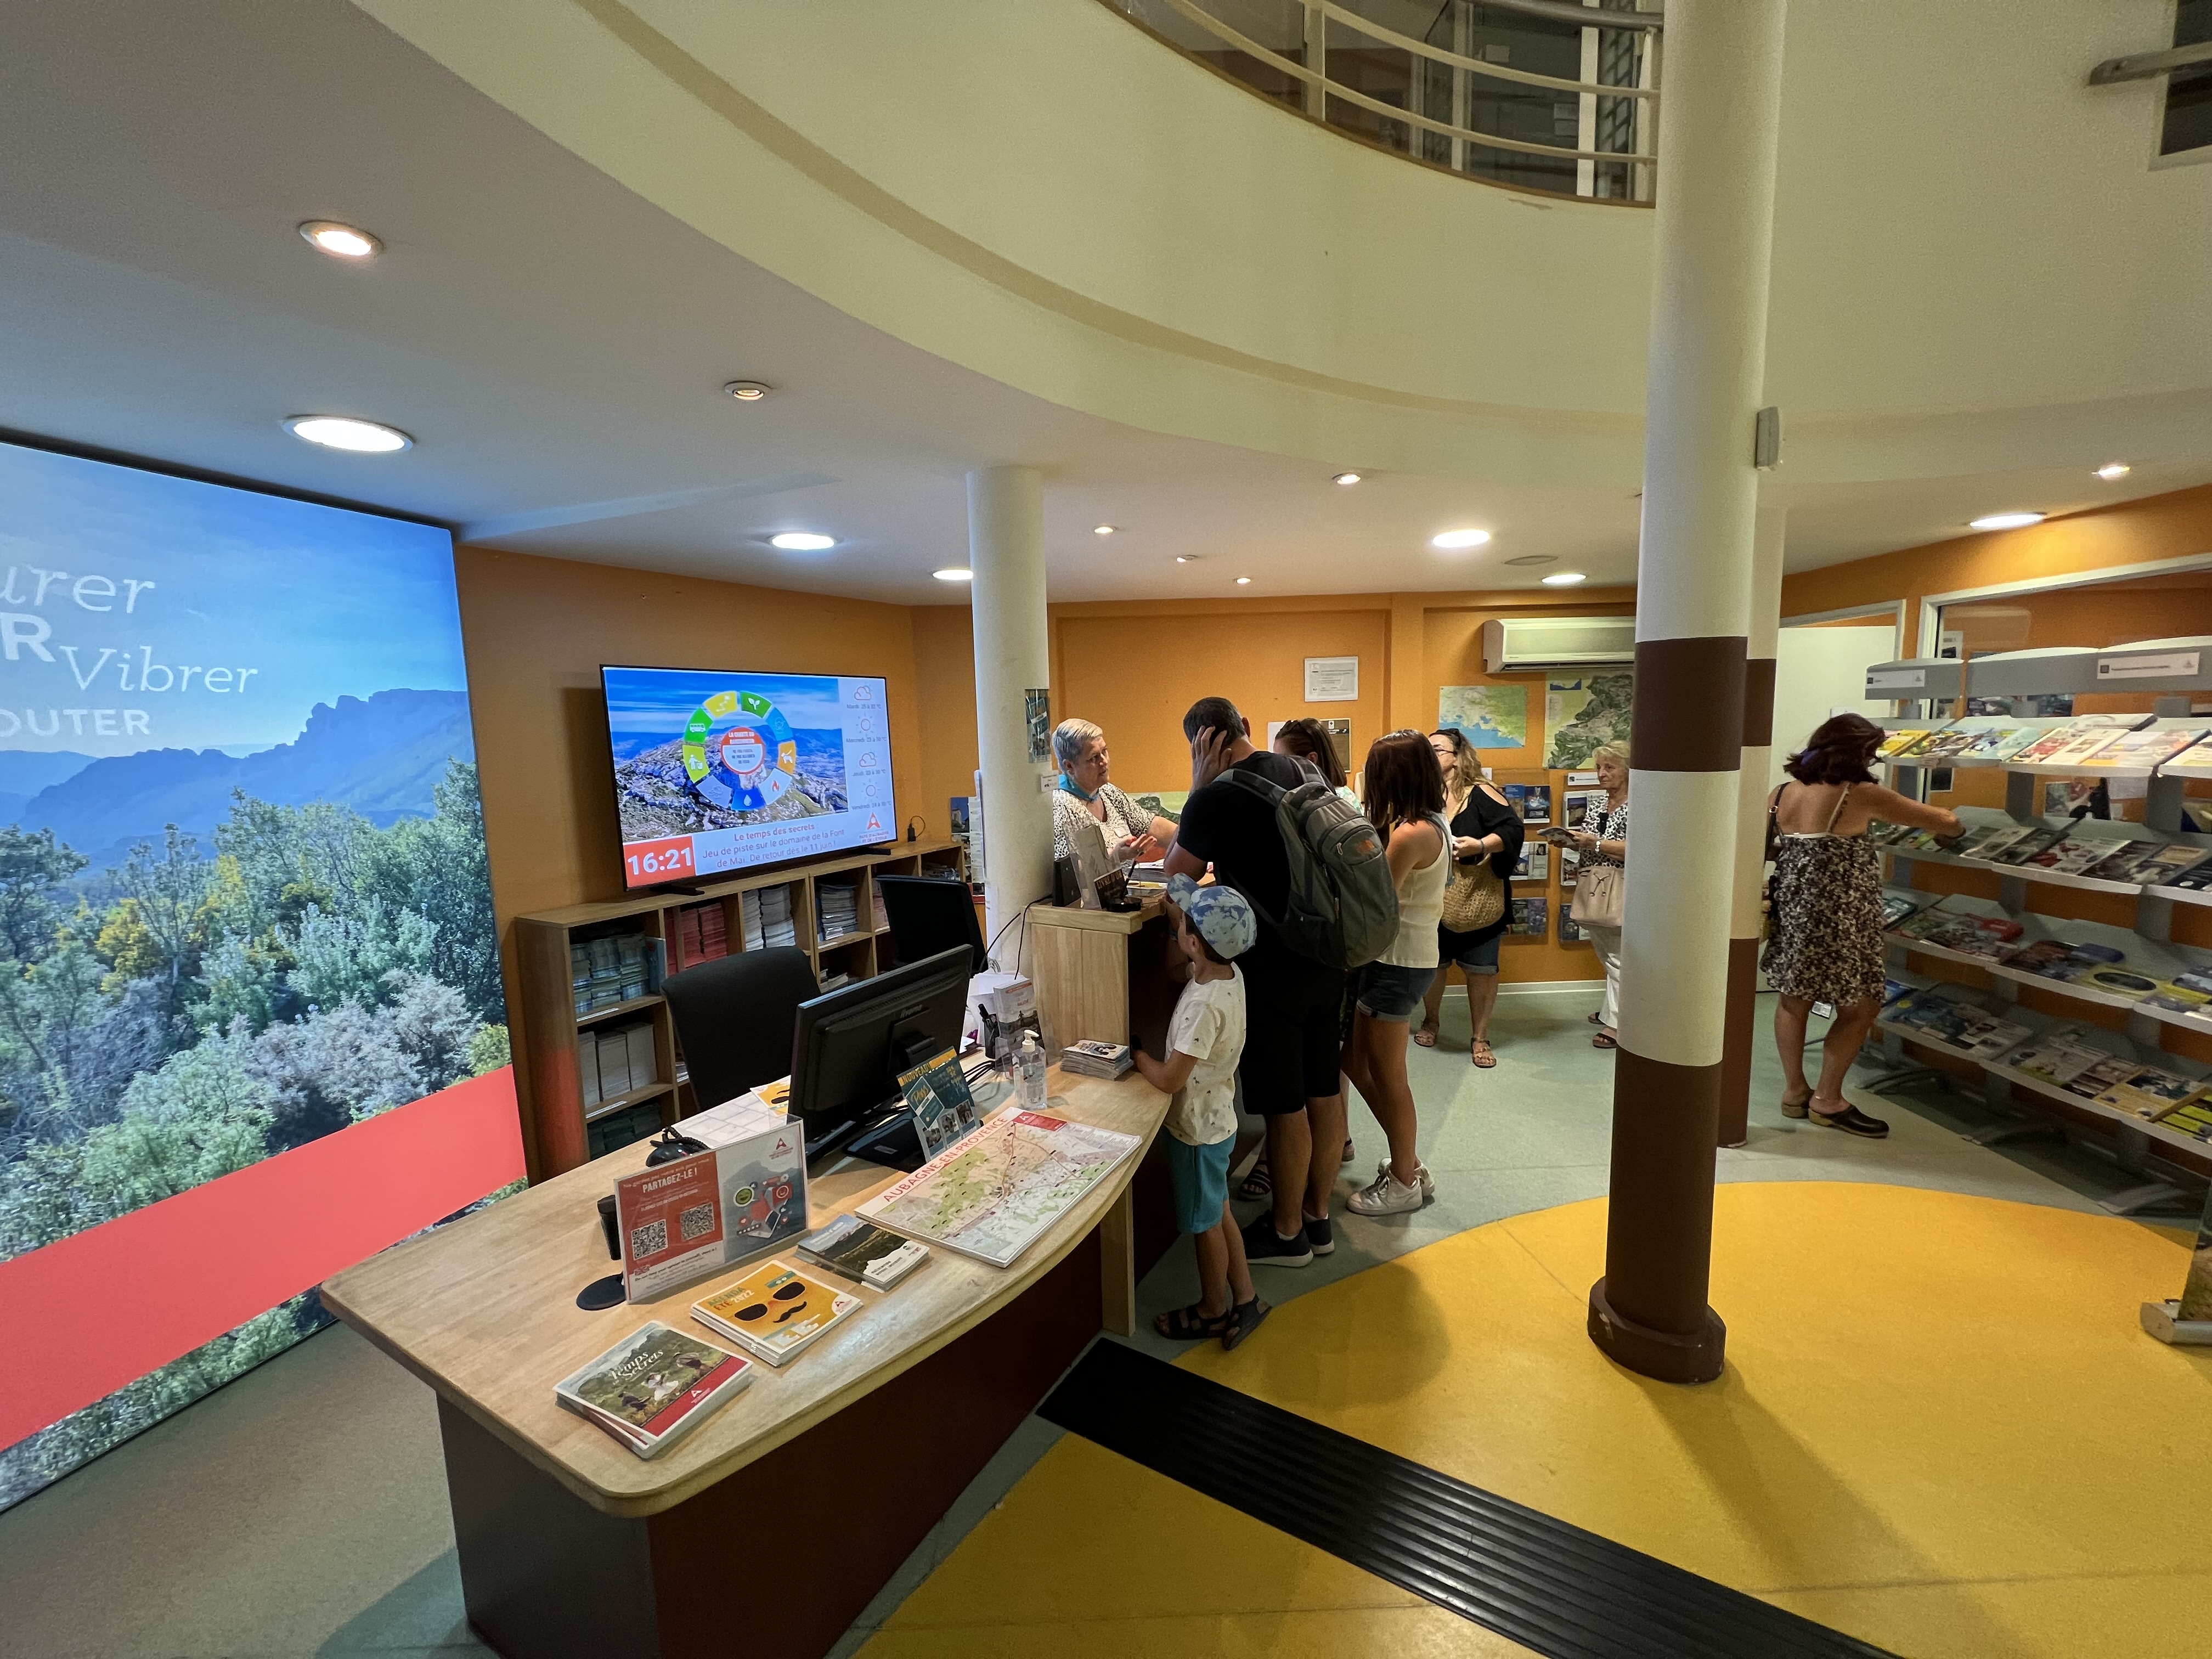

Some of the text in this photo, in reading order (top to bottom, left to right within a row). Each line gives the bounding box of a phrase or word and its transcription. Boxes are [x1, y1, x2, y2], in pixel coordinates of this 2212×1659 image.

[59, 645, 258, 693] Vibrer
[702, 850, 719, 859] Jeu
[721, 847, 732, 855] de
[733, 843, 754, 855] piste
[755, 842, 769, 850] sur
[770, 839, 777, 847] le
[778, 834, 810, 845] domaine
[812, 832, 821, 840] de
[830, 829, 845, 837] Font
[746, 829, 771, 840] temps
[772, 826, 787, 836] des
[788, 823, 815, 833] secrets
[627, 847, 692, 876] 16:21
[716, 859, 727, 868] de
[730, 856, 747, 865] Mai.
[762, 850, 785, 860] retour
[786, 846, 800, 855] dès
[809, 843, 819, 851] 11
[819, 841, 832, 851] juin
[883, 1116, 1008, 1203] AUBAGNE-EN-PROVENCE
[642, 1169, 693, 1193] PARTAGEZ-LE
[730, 1289, 755, 1303] 2022
